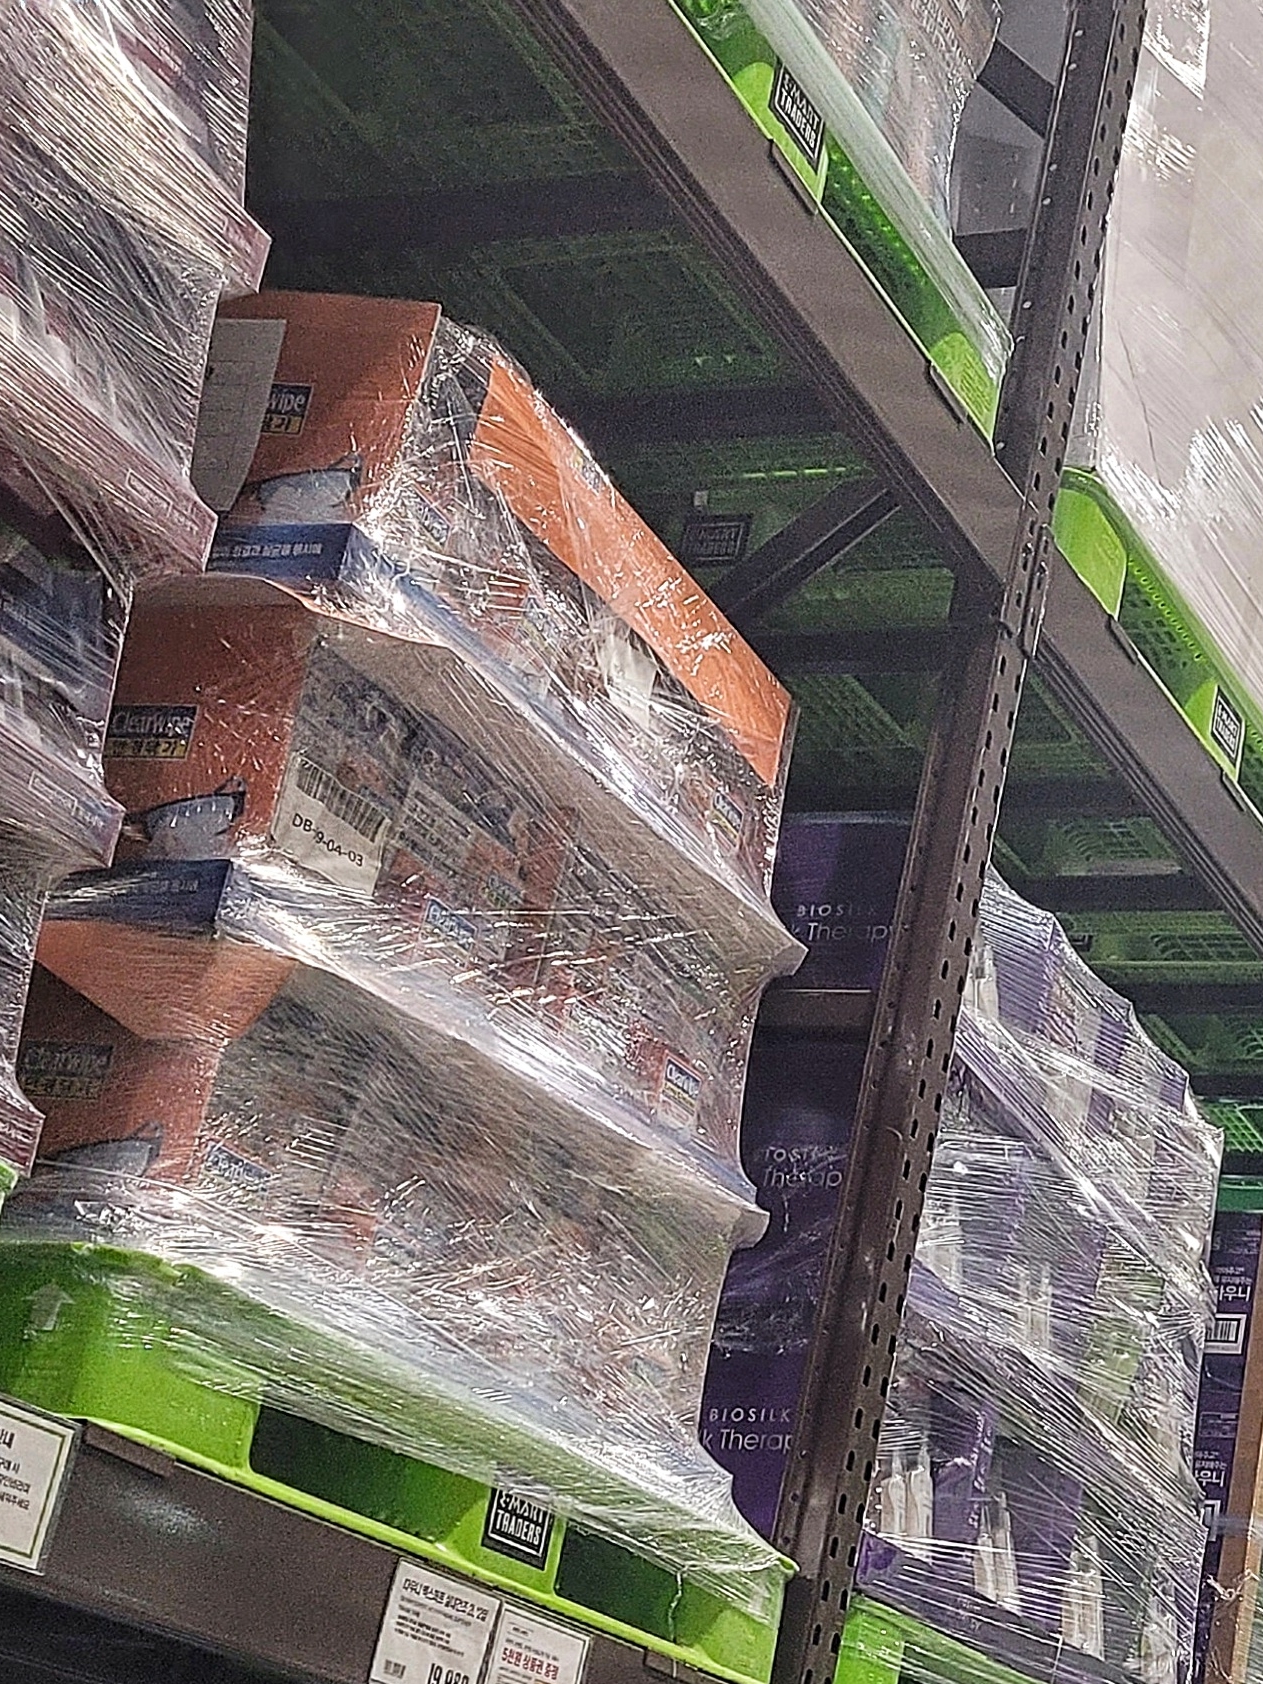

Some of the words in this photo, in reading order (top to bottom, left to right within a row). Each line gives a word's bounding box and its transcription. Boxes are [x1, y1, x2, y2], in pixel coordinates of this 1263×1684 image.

[780, 87, 816, 149] TRADERS
[291, 812, 365, 868] DB-9-04-03
[709, 1407, 792, 1423] BIOSILK
[720, 1428, 793, 1455] Therap
[494, 1508, 542, 1546] TRADERS
[500, 1647, 523, 1668] 5천원
[522, 1652, 545, 1676] 상품권
[544, 1662, 560, 1681] 증정
